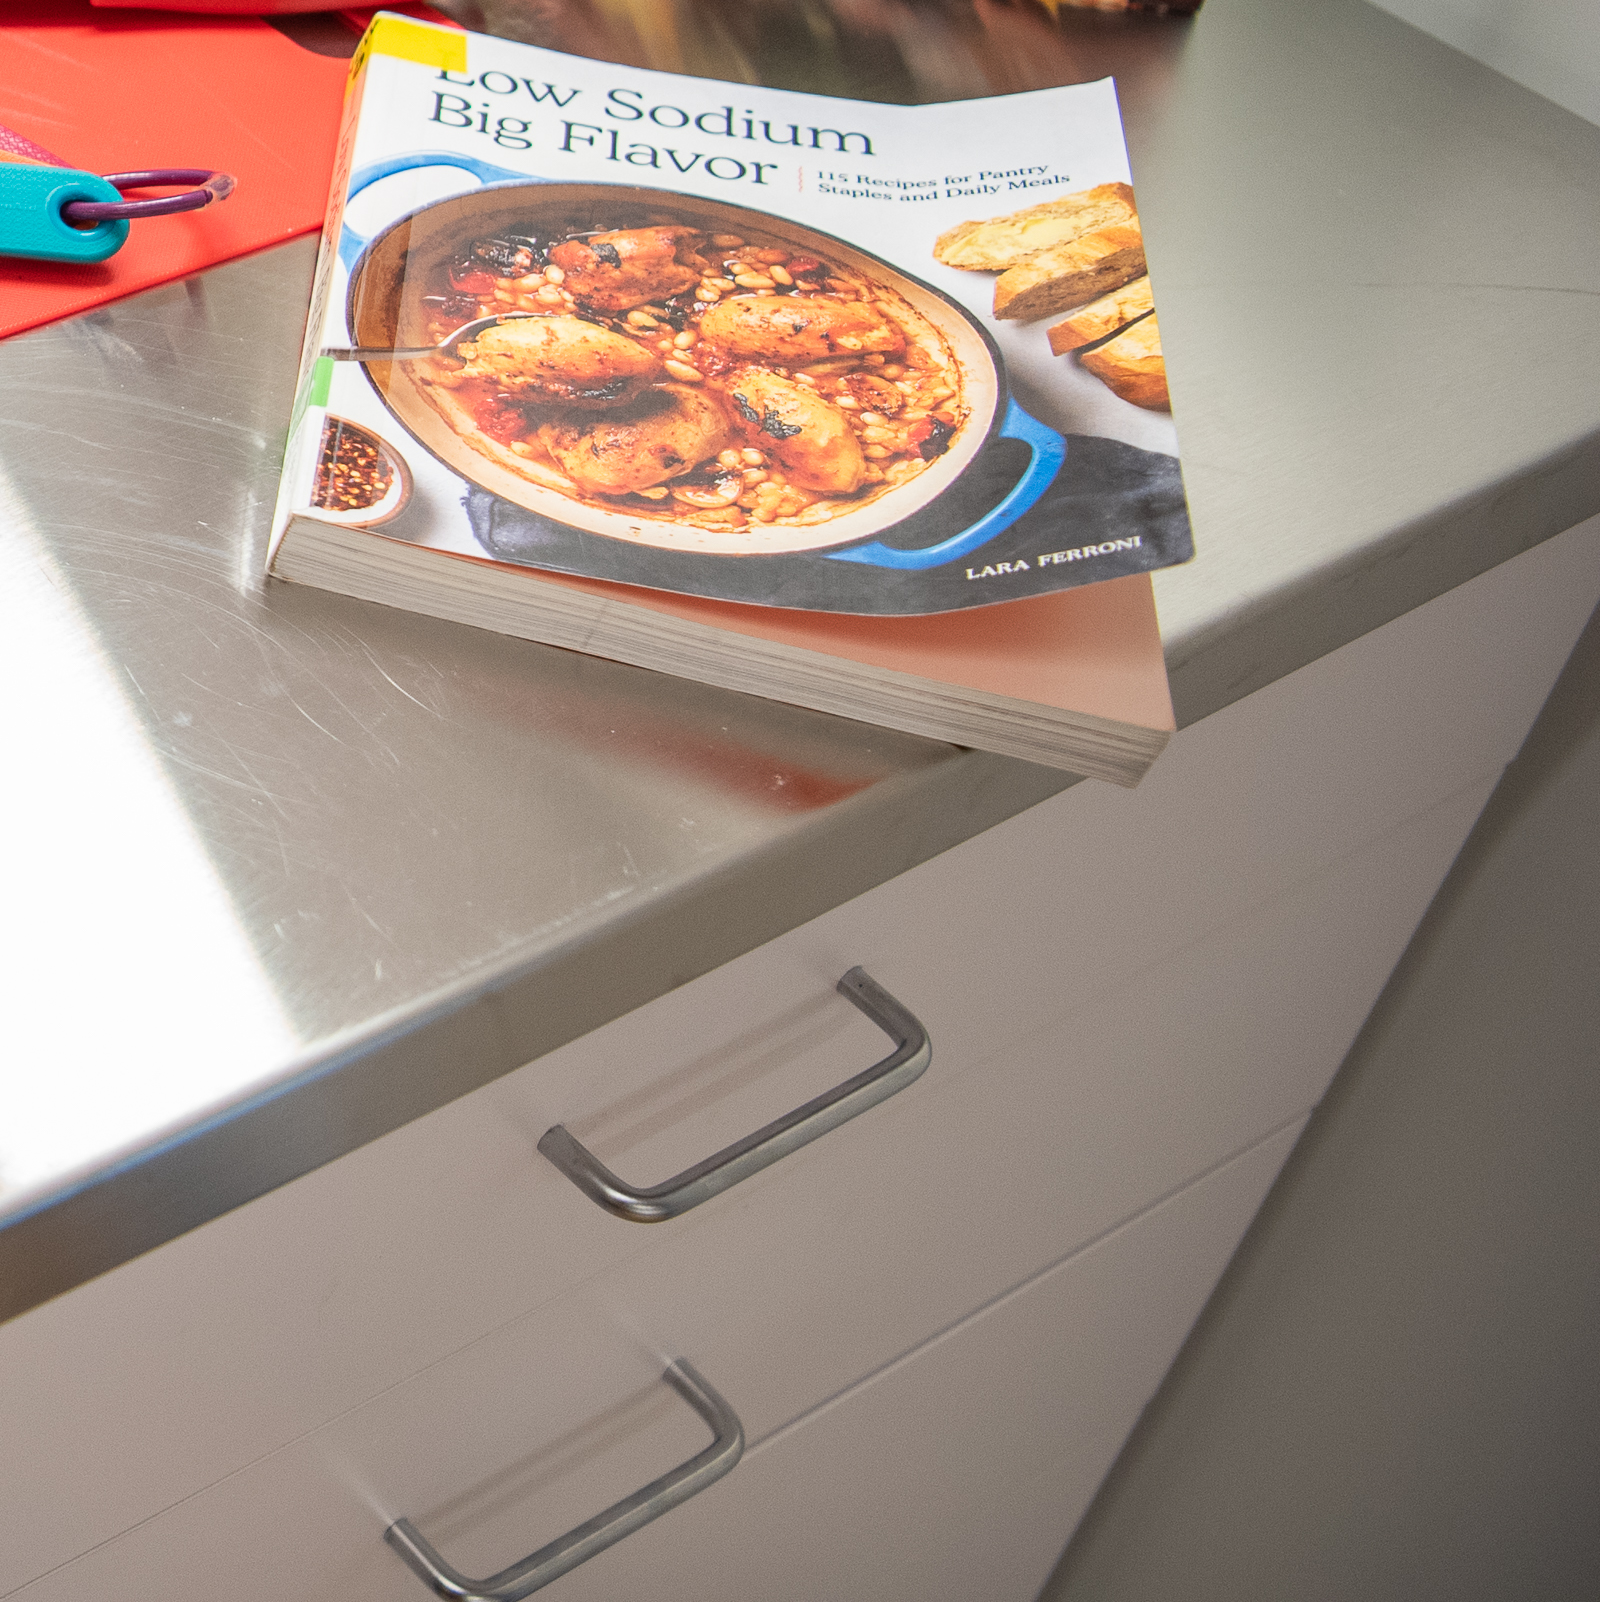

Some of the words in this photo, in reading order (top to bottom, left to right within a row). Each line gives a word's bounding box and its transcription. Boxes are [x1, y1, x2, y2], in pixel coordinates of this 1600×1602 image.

[429, 90, 534, 150] Big
[558, 120, 779, 185] Flavor
[604, 88, 877, 156] Sodium
[817, 170, 850, 184] 115
[856, 174, 938, 190] Recipes
[943, 173, 973, 186] for
[978, 164, 1050, 182] Pantry
[818, 182, 893, 202] Staples
[899, 190, 939, 202] and
[946, 183, 1001, 199] Daily
[1007, 173, 1071, 191] Meals
[965, 559, 1031, 581] LARA
[1037, 535, 1143, 567] FERRONI
